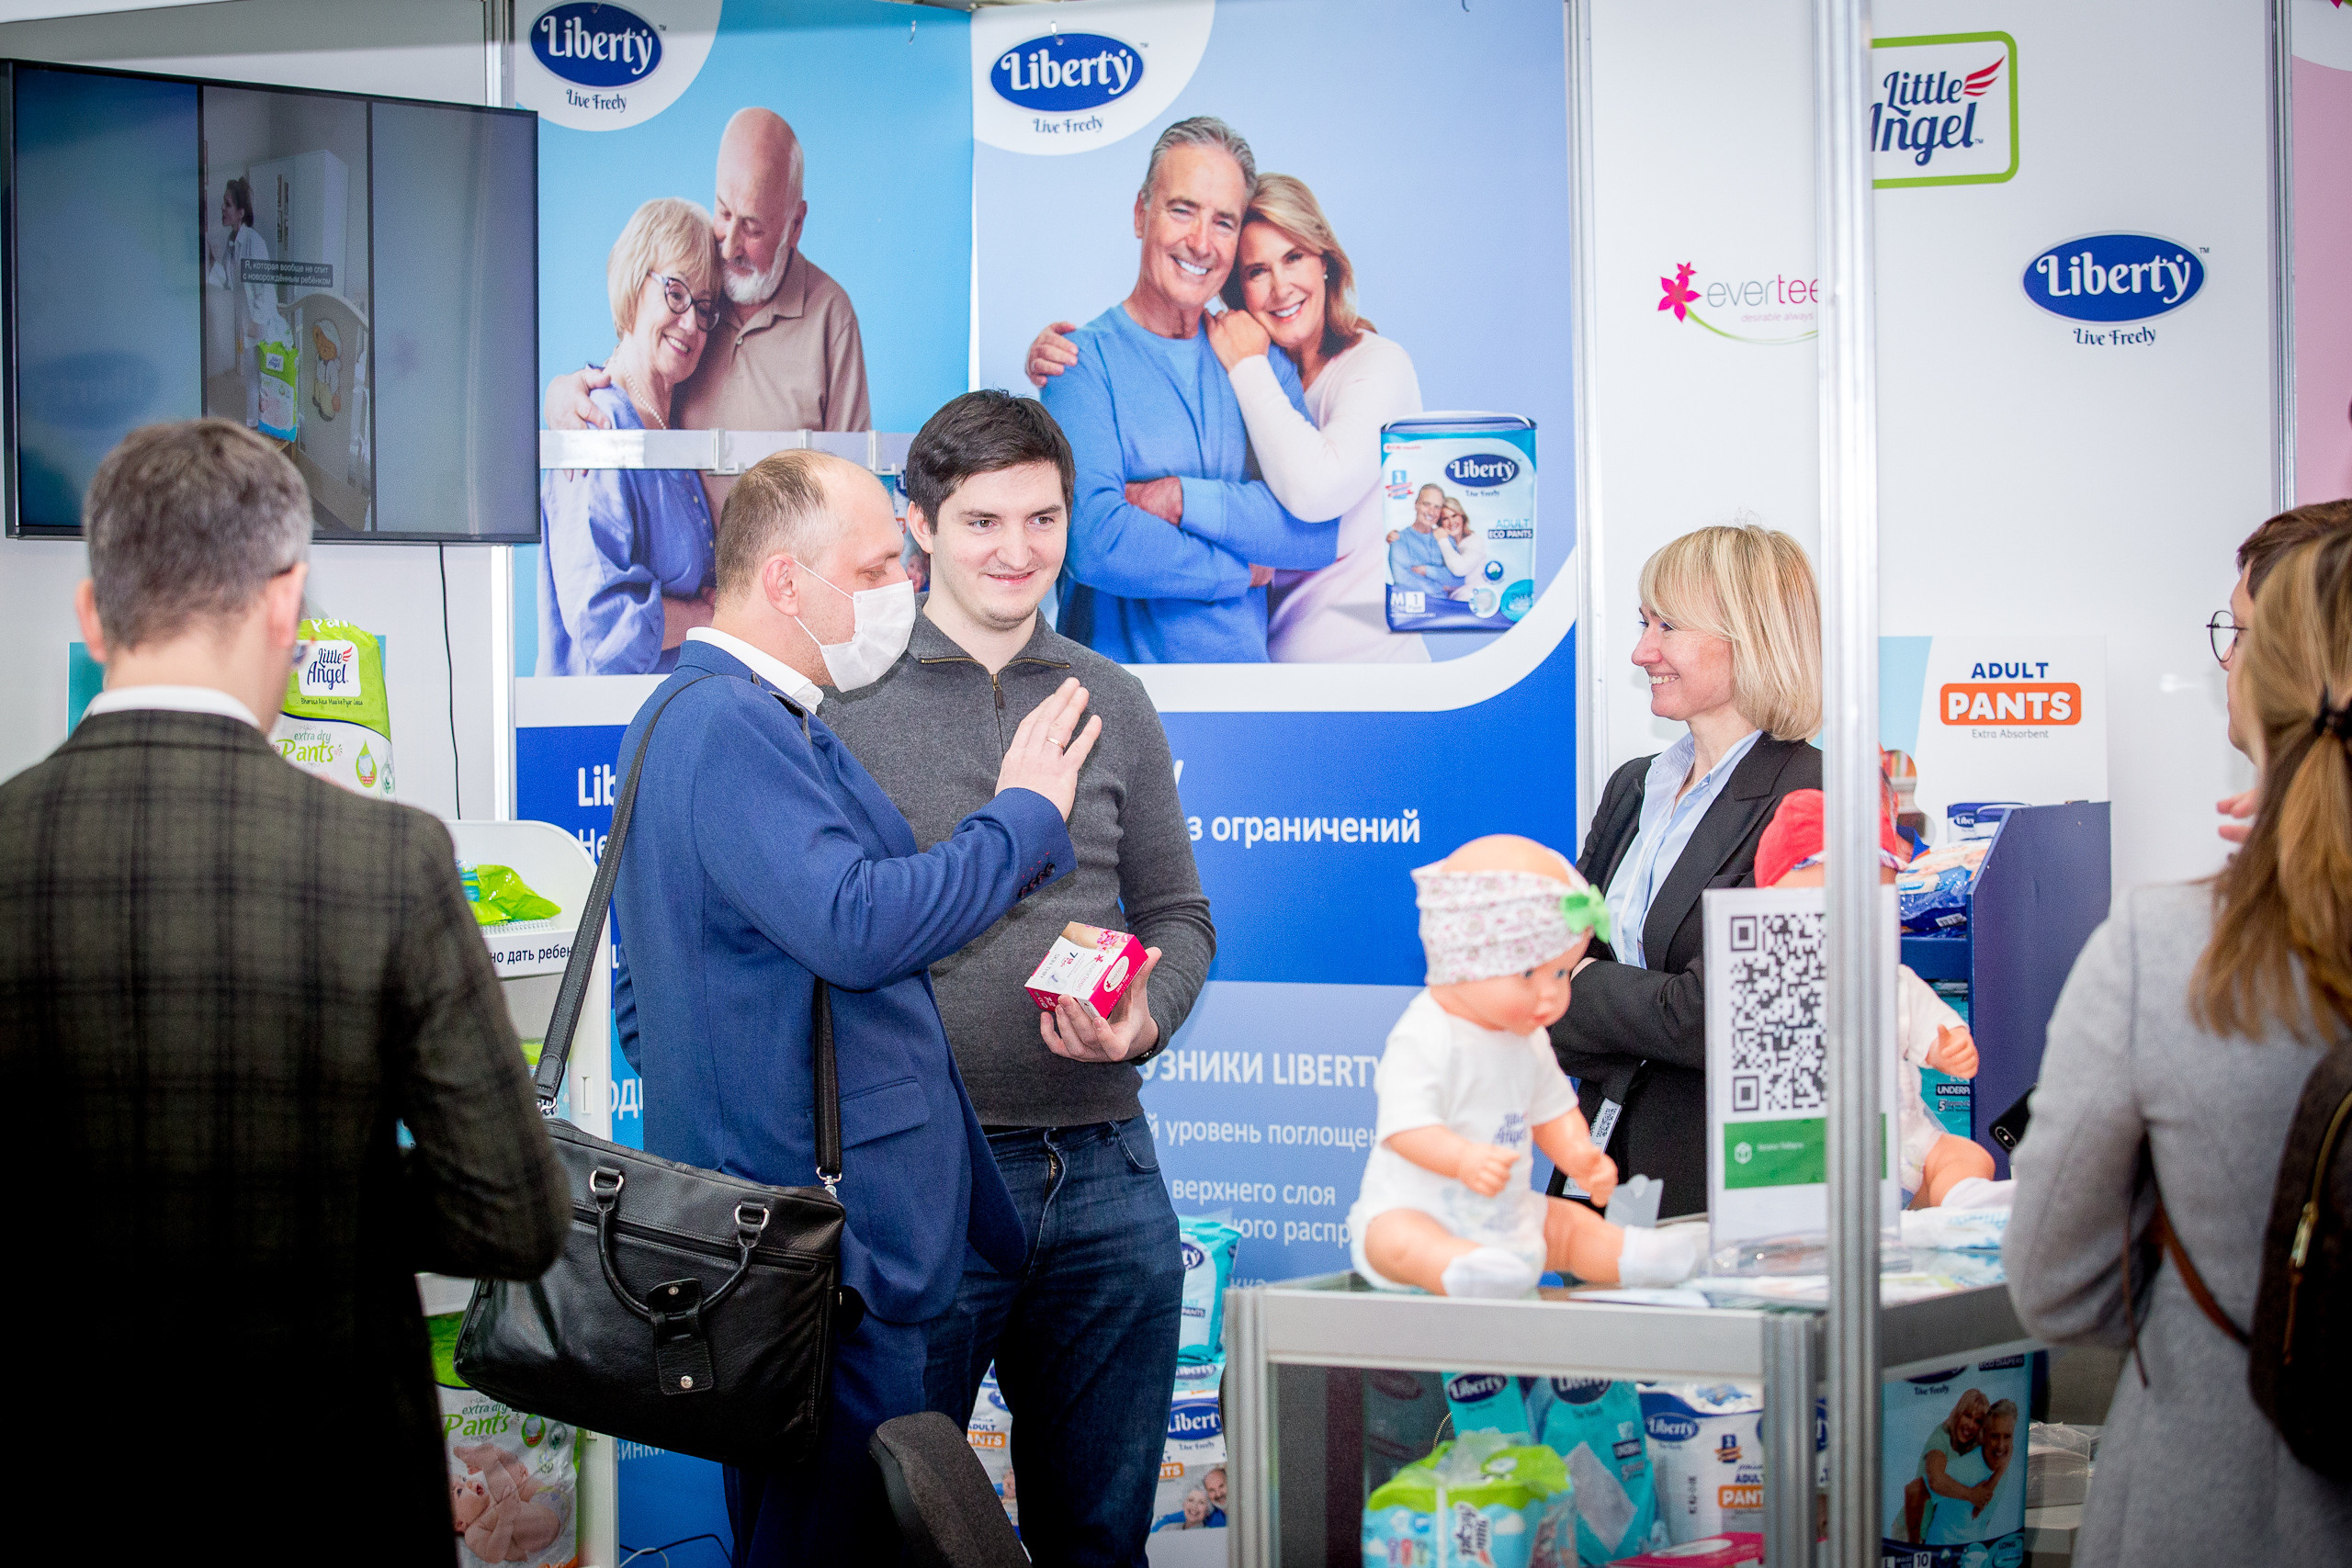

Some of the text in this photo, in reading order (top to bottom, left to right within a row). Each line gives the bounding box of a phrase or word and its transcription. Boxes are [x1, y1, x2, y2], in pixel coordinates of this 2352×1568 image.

[540, 15, 653, 75] Liberty
[1001, 48, 1133, 96] Liberty
[566, 88, 627, 113] Live Freely
[1883, 71, 1962, 117] Little
[1033, 115, 1103, 133] Live Freely
[2036, 251, 2191, 304] Liberty
[1783, 311, 1815, 321] always
[2073, 326, 2156, 346] Live Freely
[1450, 459, 1516, 481] Liberty
[1488, 530, 1532, 538] ECO PANTS
[1496, 519, 1531, 529] ADULT
[318, 648, 343, 668] Little
[307, 660, 346, 690] Angel
[1971, 662, 2049, 679] ADULT
[1948, 691, 2073, 721] PANTS
[294, 728, 332, 744] extra dry
[1972, 728, 2049, 739] Extra Absorbent
[276, 739, 334, 763] Pants
[1211, 808, 1420, 850] ограничений
[507, 949, 535, 964] дать
[1165, 1120, 1261, 1146] уровень
[1172, 1179, 1336, 1206] верхнего слоя
[462, 1404, 489, 1416] extra
[441, 1411, 510, 1441] Pants
[1736, 1473, 1763, 1483] ADUL
[1916, 1553, 1928, 1567] 10
